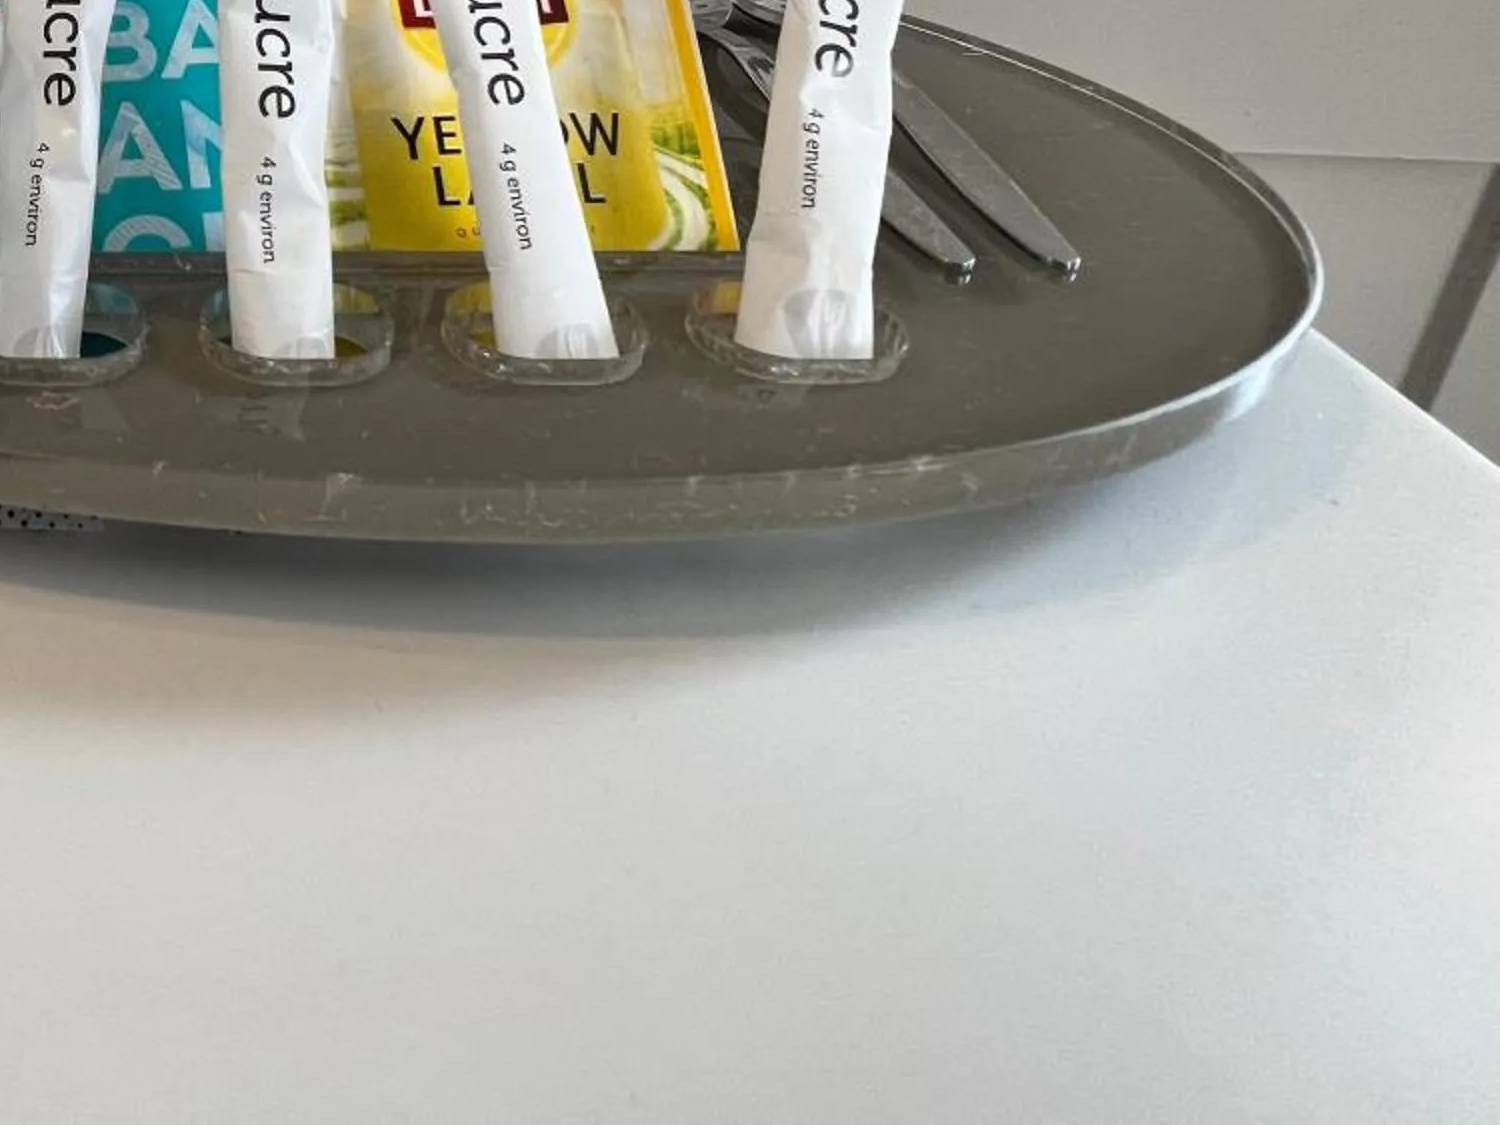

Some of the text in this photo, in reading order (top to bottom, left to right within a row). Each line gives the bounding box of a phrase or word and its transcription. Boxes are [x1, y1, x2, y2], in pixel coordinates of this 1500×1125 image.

[98, 99, 223, 195] AN
[390, 112, 620, 161] YEW
[800, 107, 824, 209] 4 g environ
[25, 141, 50, 248] 4 g environ
[256, 155, 277, 264] 4 g environ
[499, 142, 533, 251] 4 g environ
